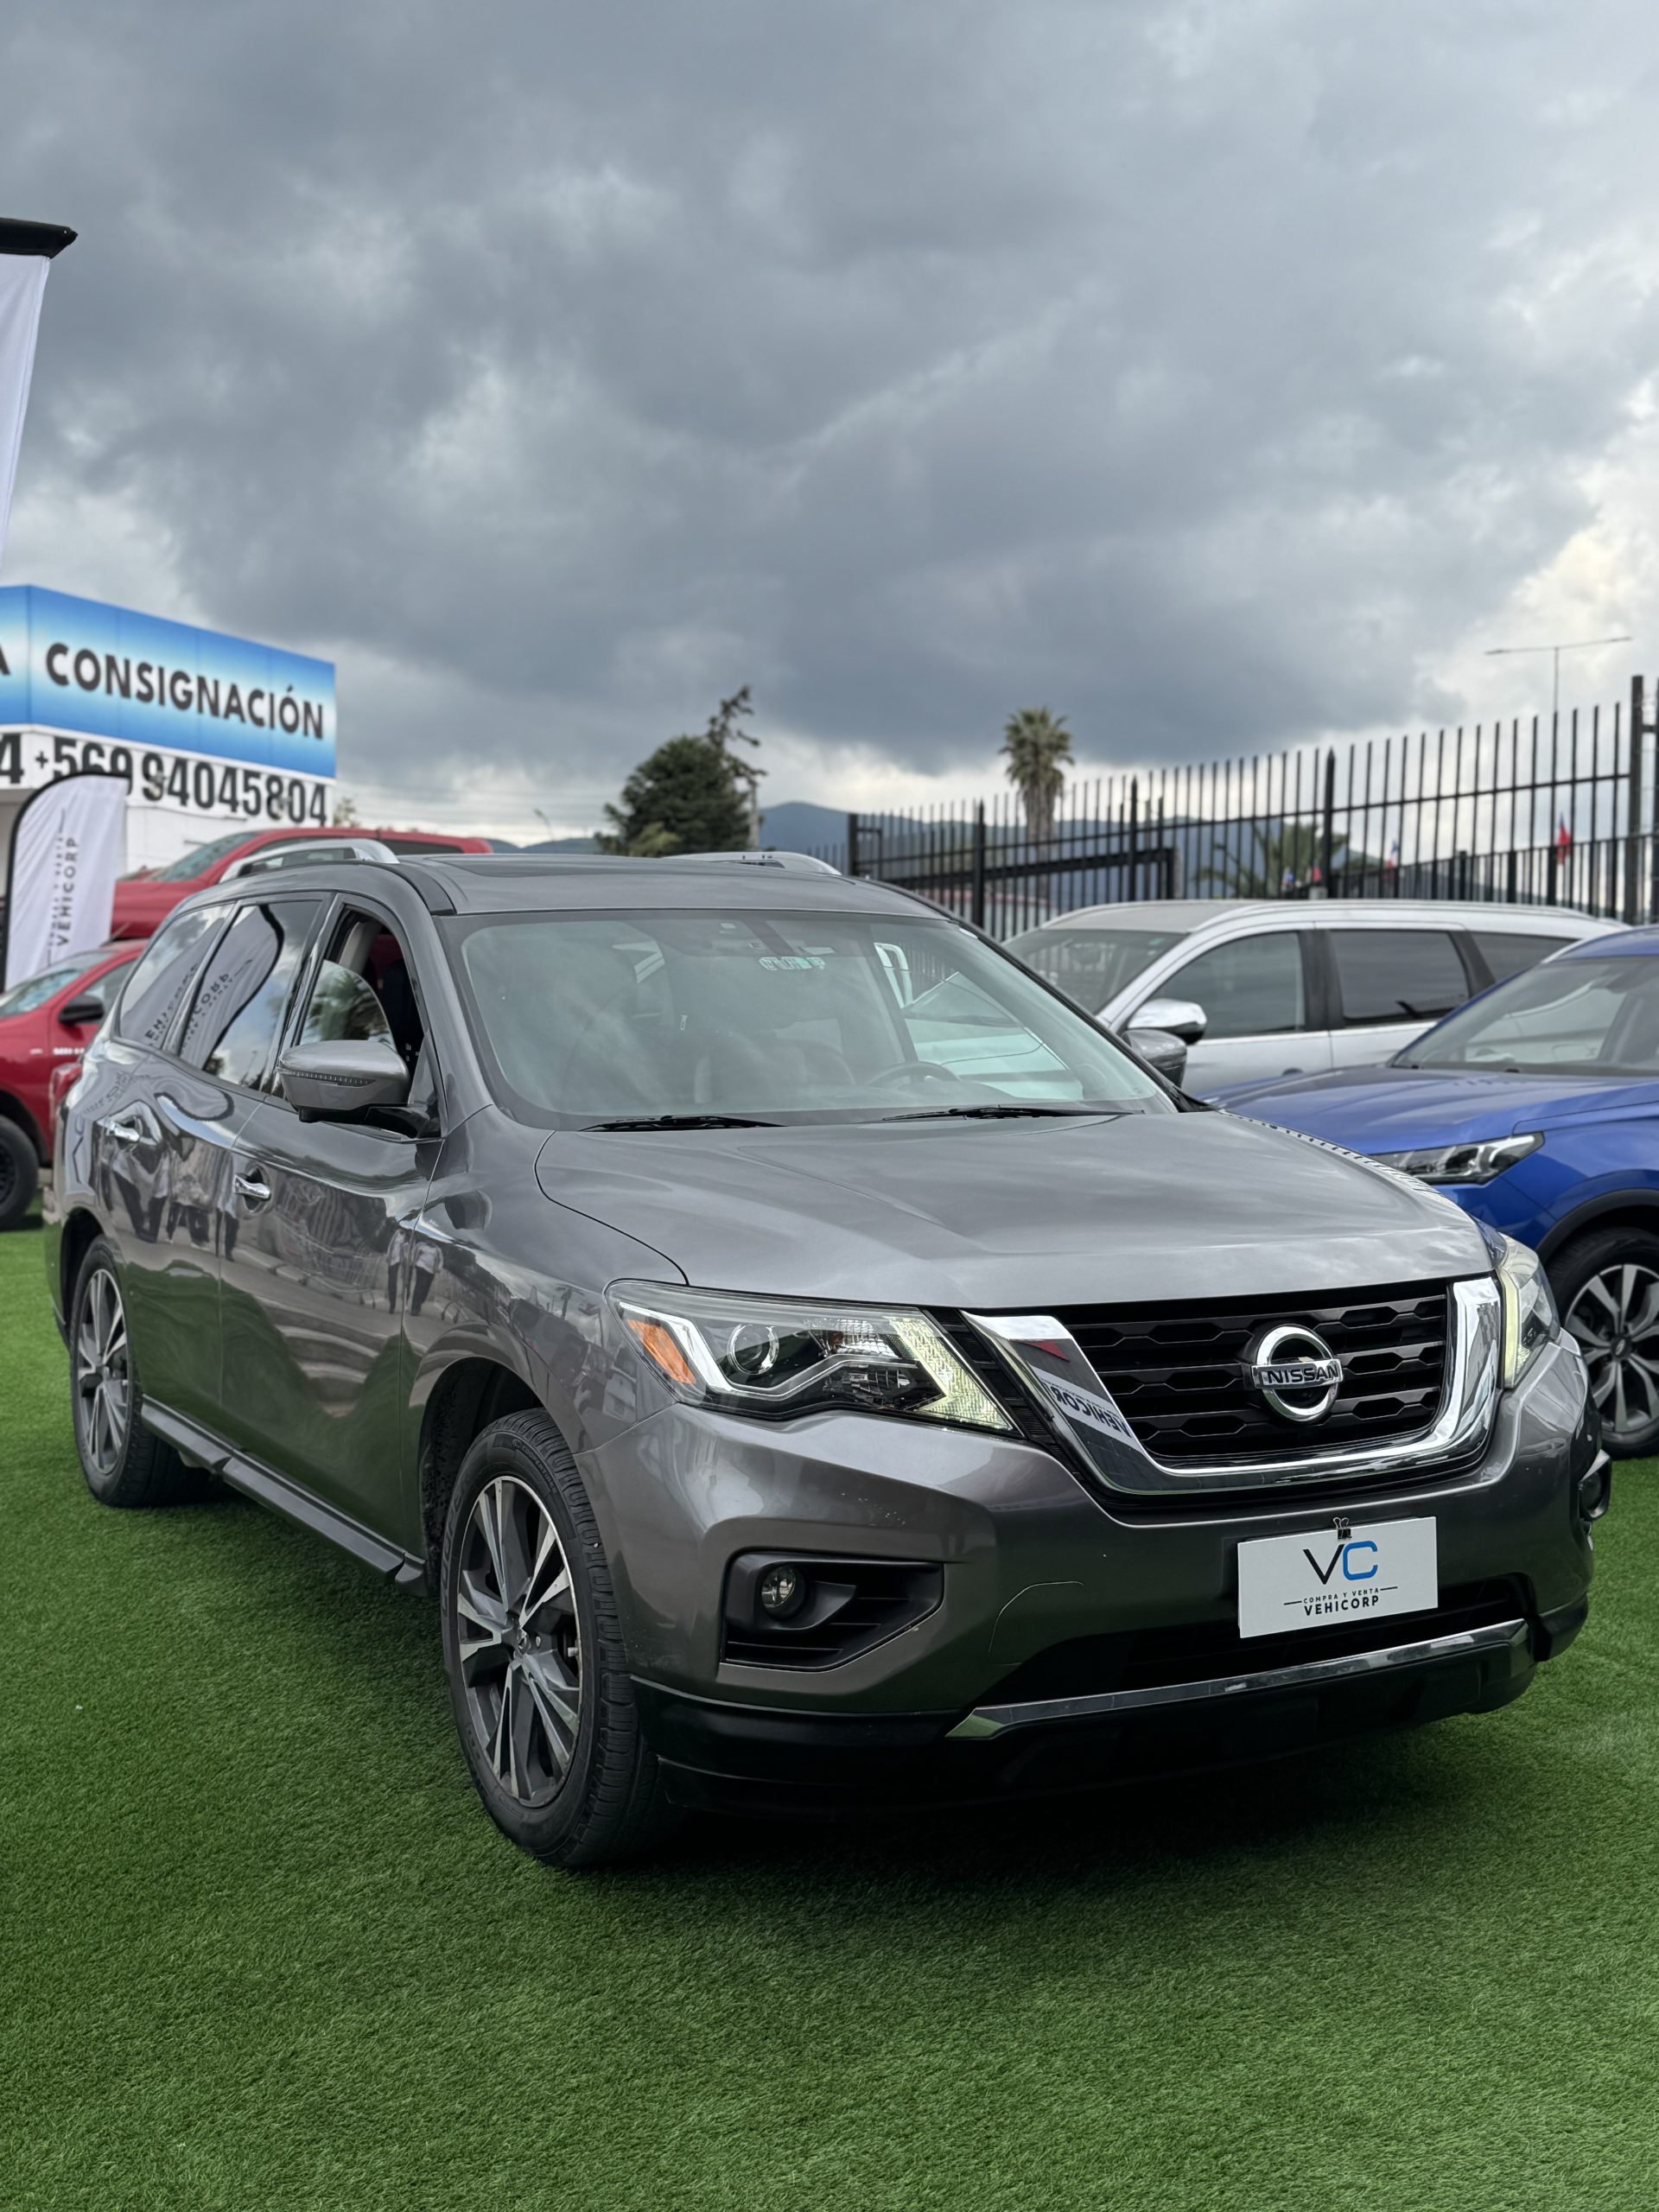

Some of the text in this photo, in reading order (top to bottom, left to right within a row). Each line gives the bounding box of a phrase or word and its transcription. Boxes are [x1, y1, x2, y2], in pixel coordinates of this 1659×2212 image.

[46, 642, 324, 741] CONSIGNACIÓN
[56, 837, 79, 947] VEHICORP
[1267, 1363, 1339, 1384] NISSAN
[1303, 1541, 1378, 1585] VC
[1303, 1593, 1338, 1605] COMPRA
[1351, 1587, 1379, 1597] VENTA
[1304, 1595, 1379, 1616] VEHICORP
